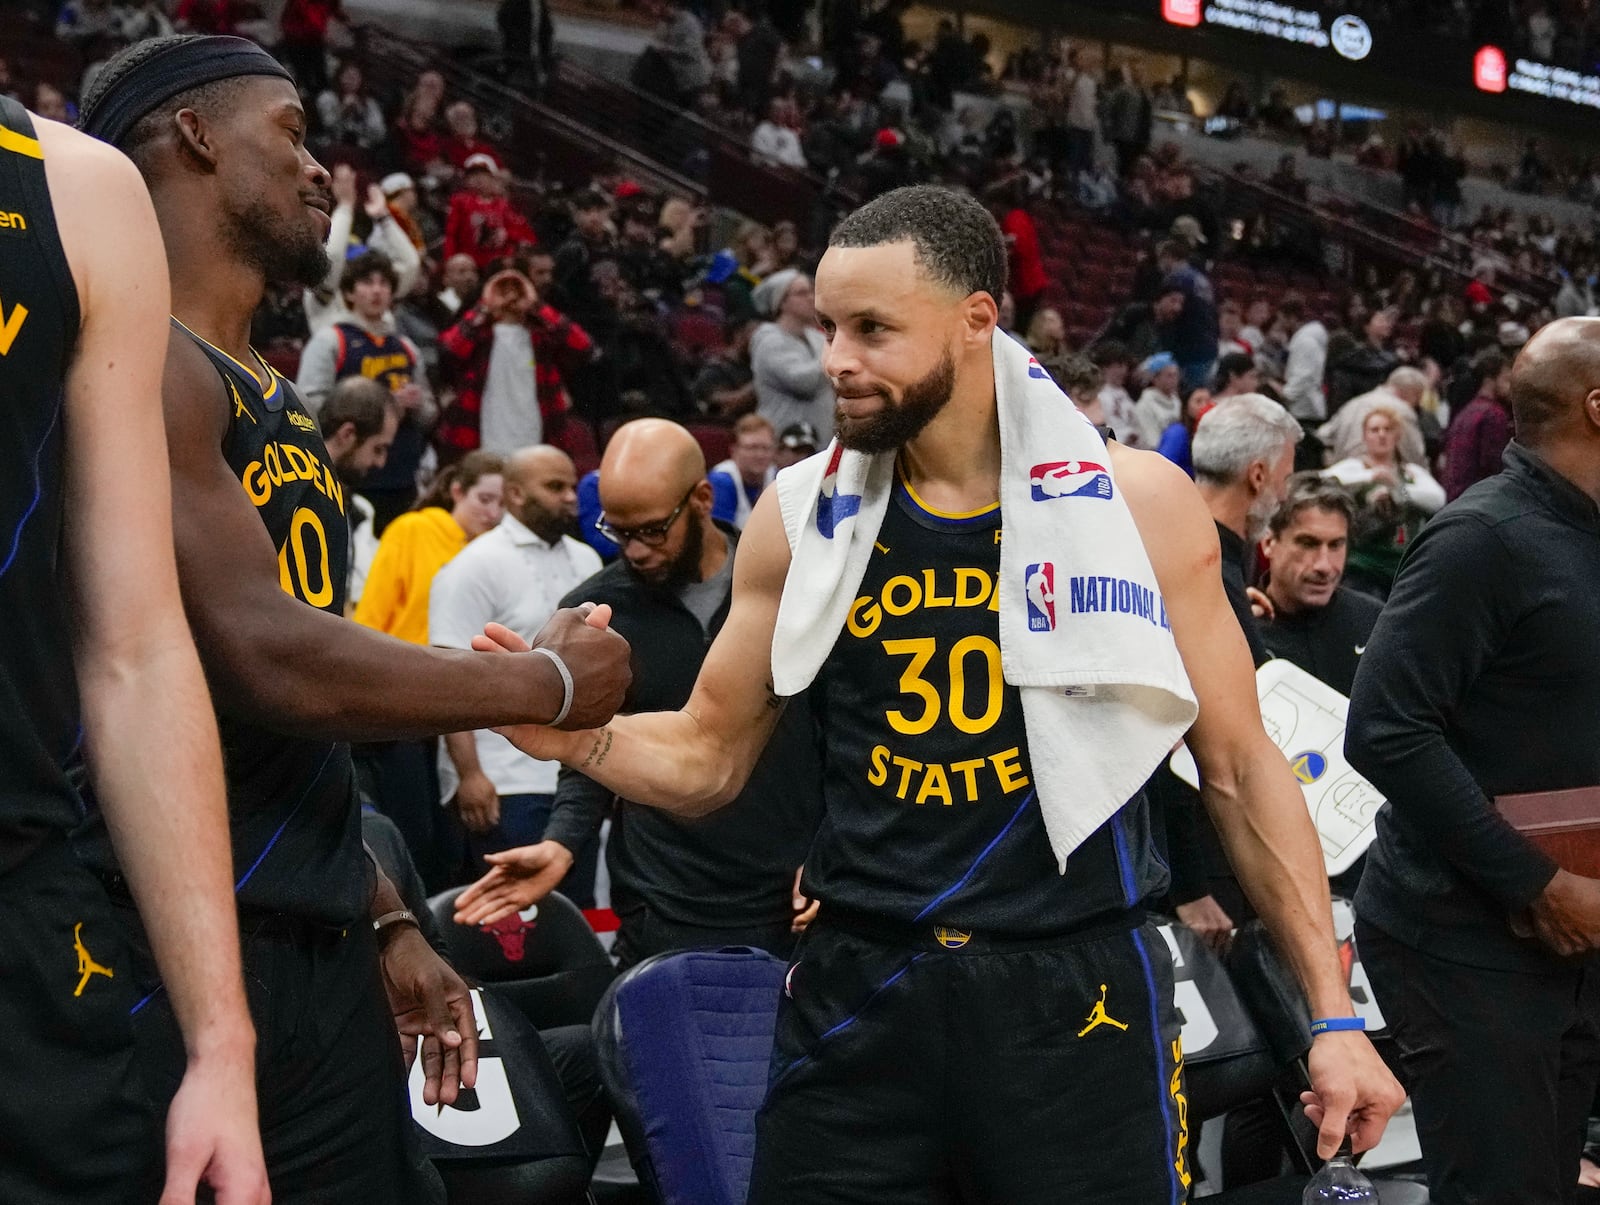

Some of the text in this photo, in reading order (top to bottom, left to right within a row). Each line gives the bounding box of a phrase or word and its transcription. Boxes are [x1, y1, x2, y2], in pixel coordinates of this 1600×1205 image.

[243, 441, 344, 516] GOLDEN
[1097, 477, 1110, 497] NBA
[1031, 617, 1047, 629] NBA
[1070, 576, 1156, 626] NATIONAL
[881, 635, 1004, 735] 30
[868, 744, 1029, 806] STATE
